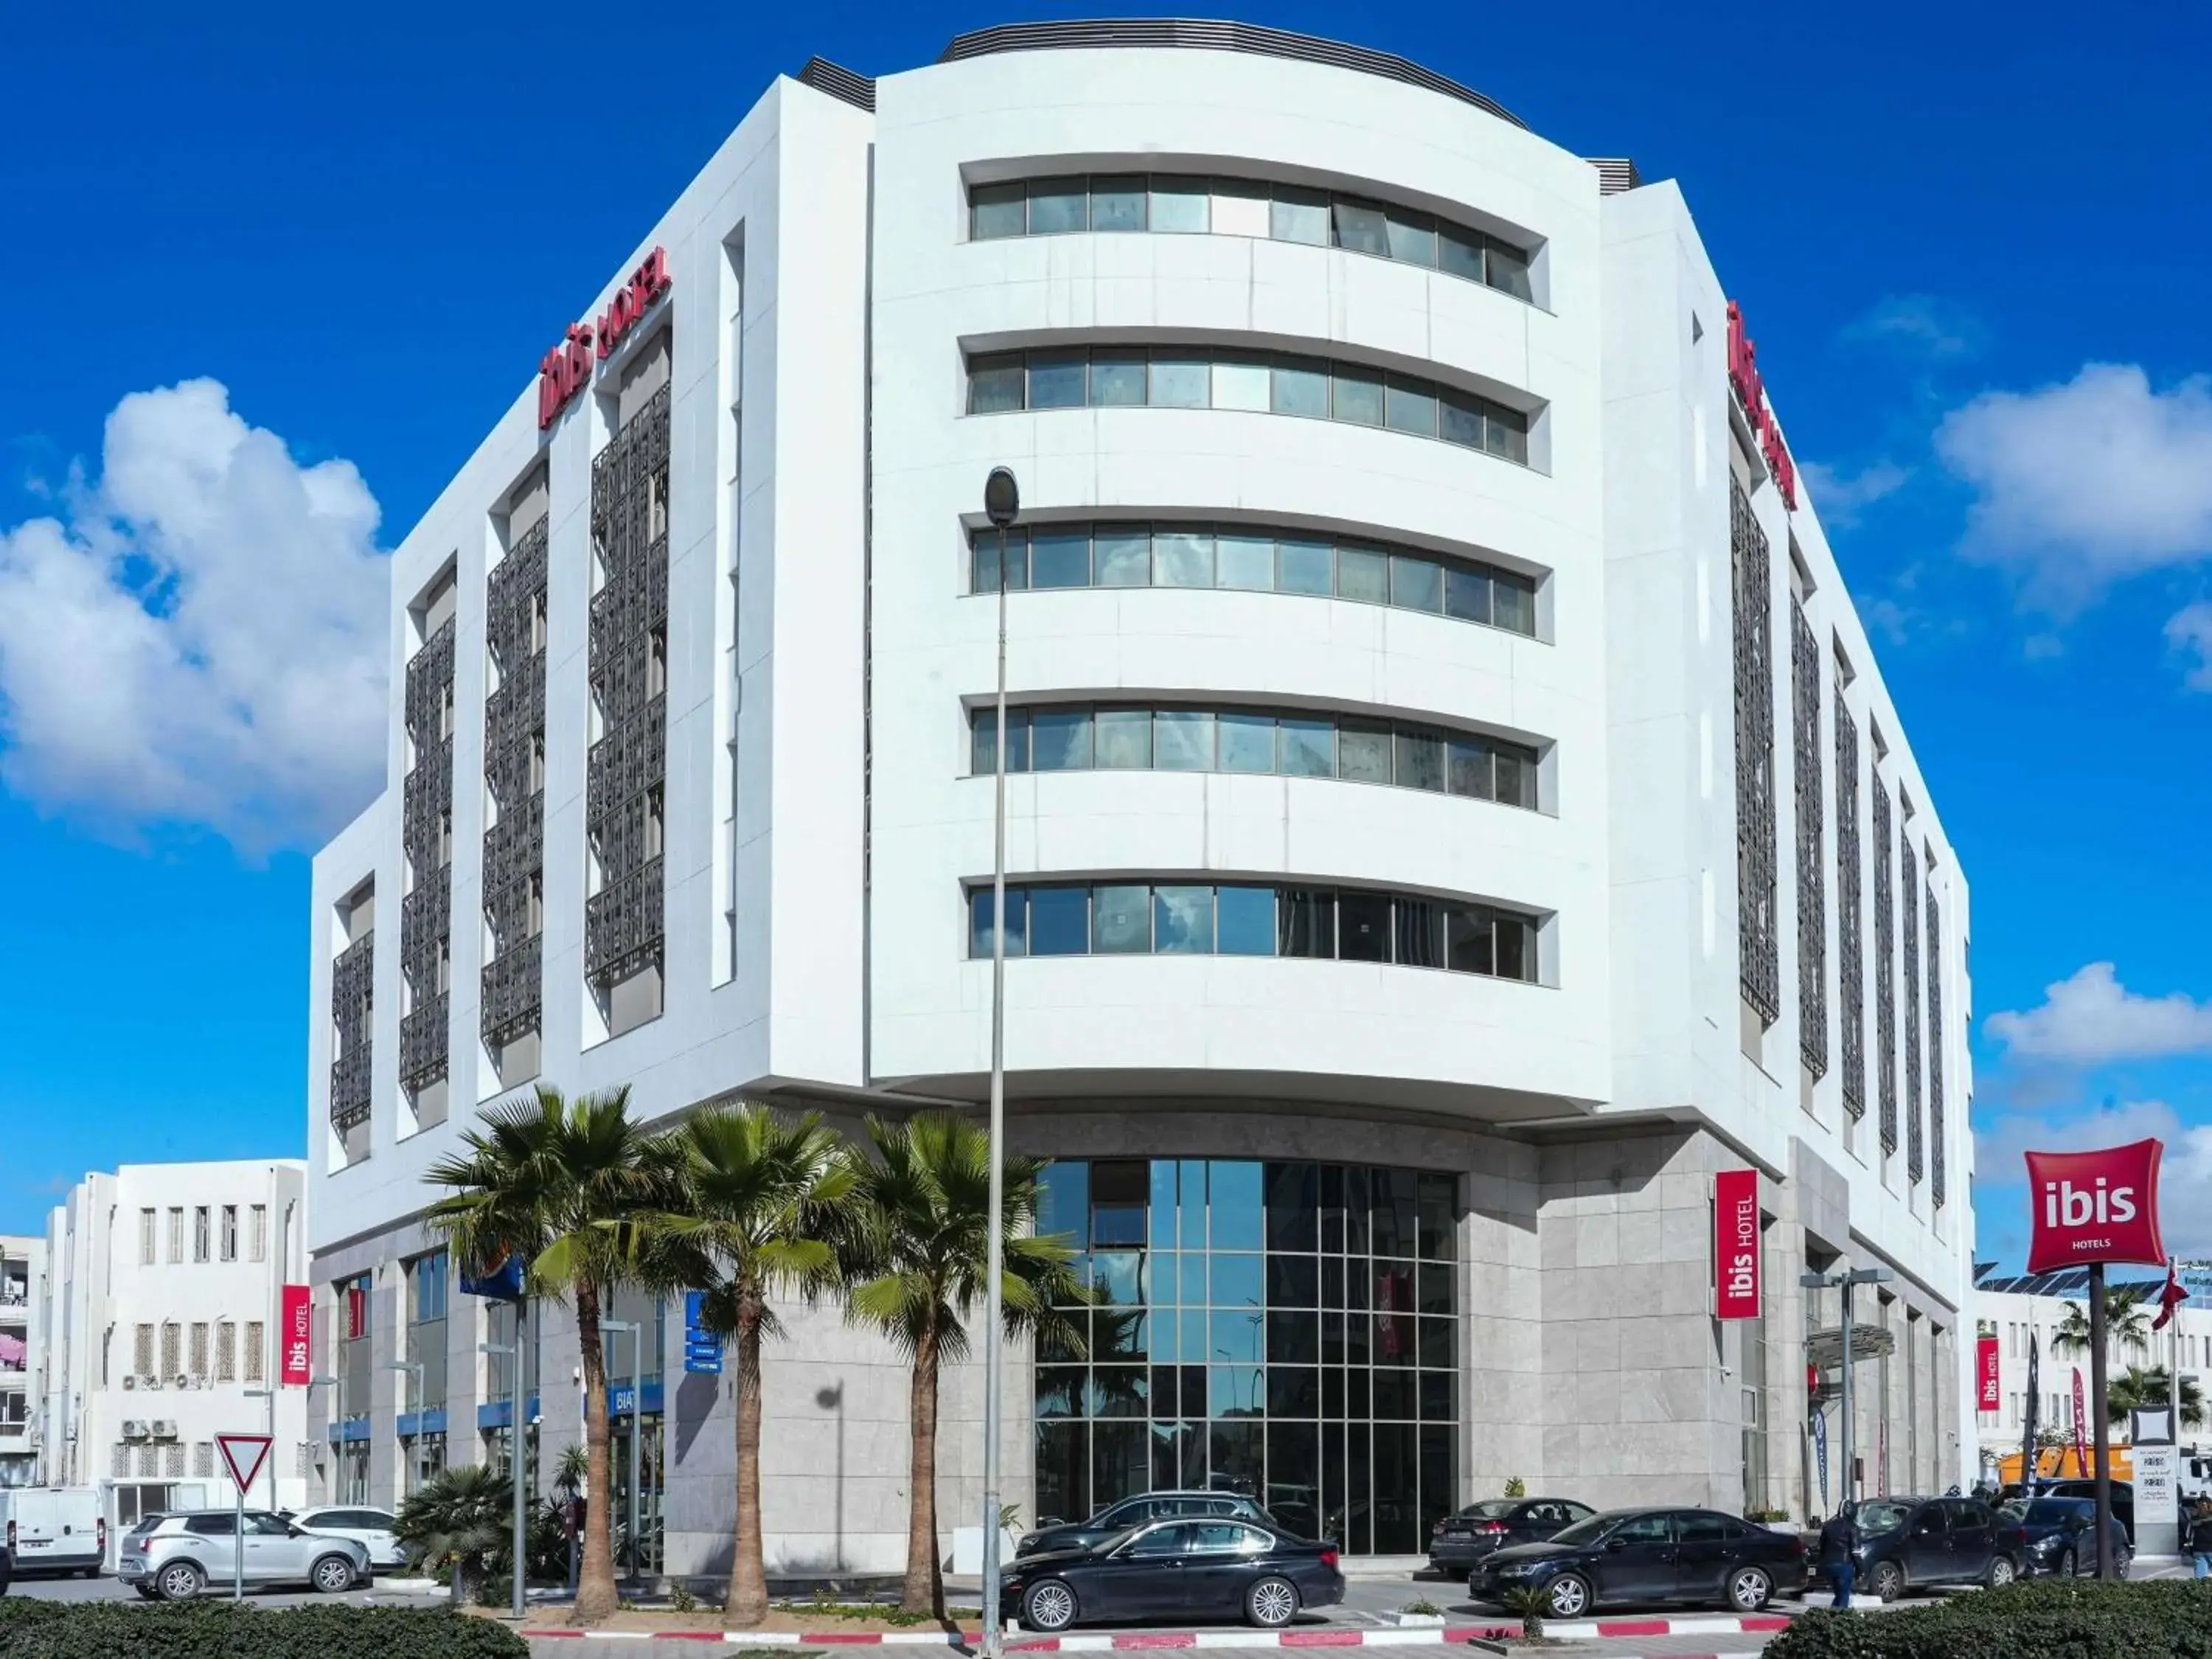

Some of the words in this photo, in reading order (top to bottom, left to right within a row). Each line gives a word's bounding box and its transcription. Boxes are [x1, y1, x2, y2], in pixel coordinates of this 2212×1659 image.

[2046, 1178, 2136, 1228] ibis
[1737, 1194, 1753, 1247] HOTEL
[2072, 1239, 2112, 1250] HOTELS
[1728, 1253, 1753, 1298] ibis
[296, 1303, 307, 1337] HOTEL
[288, 1342, 307, 1371] ibis
[1988, 1351, 1997, 1377] HOTEL
[1983, 1380, 1997, 1401] ibis
